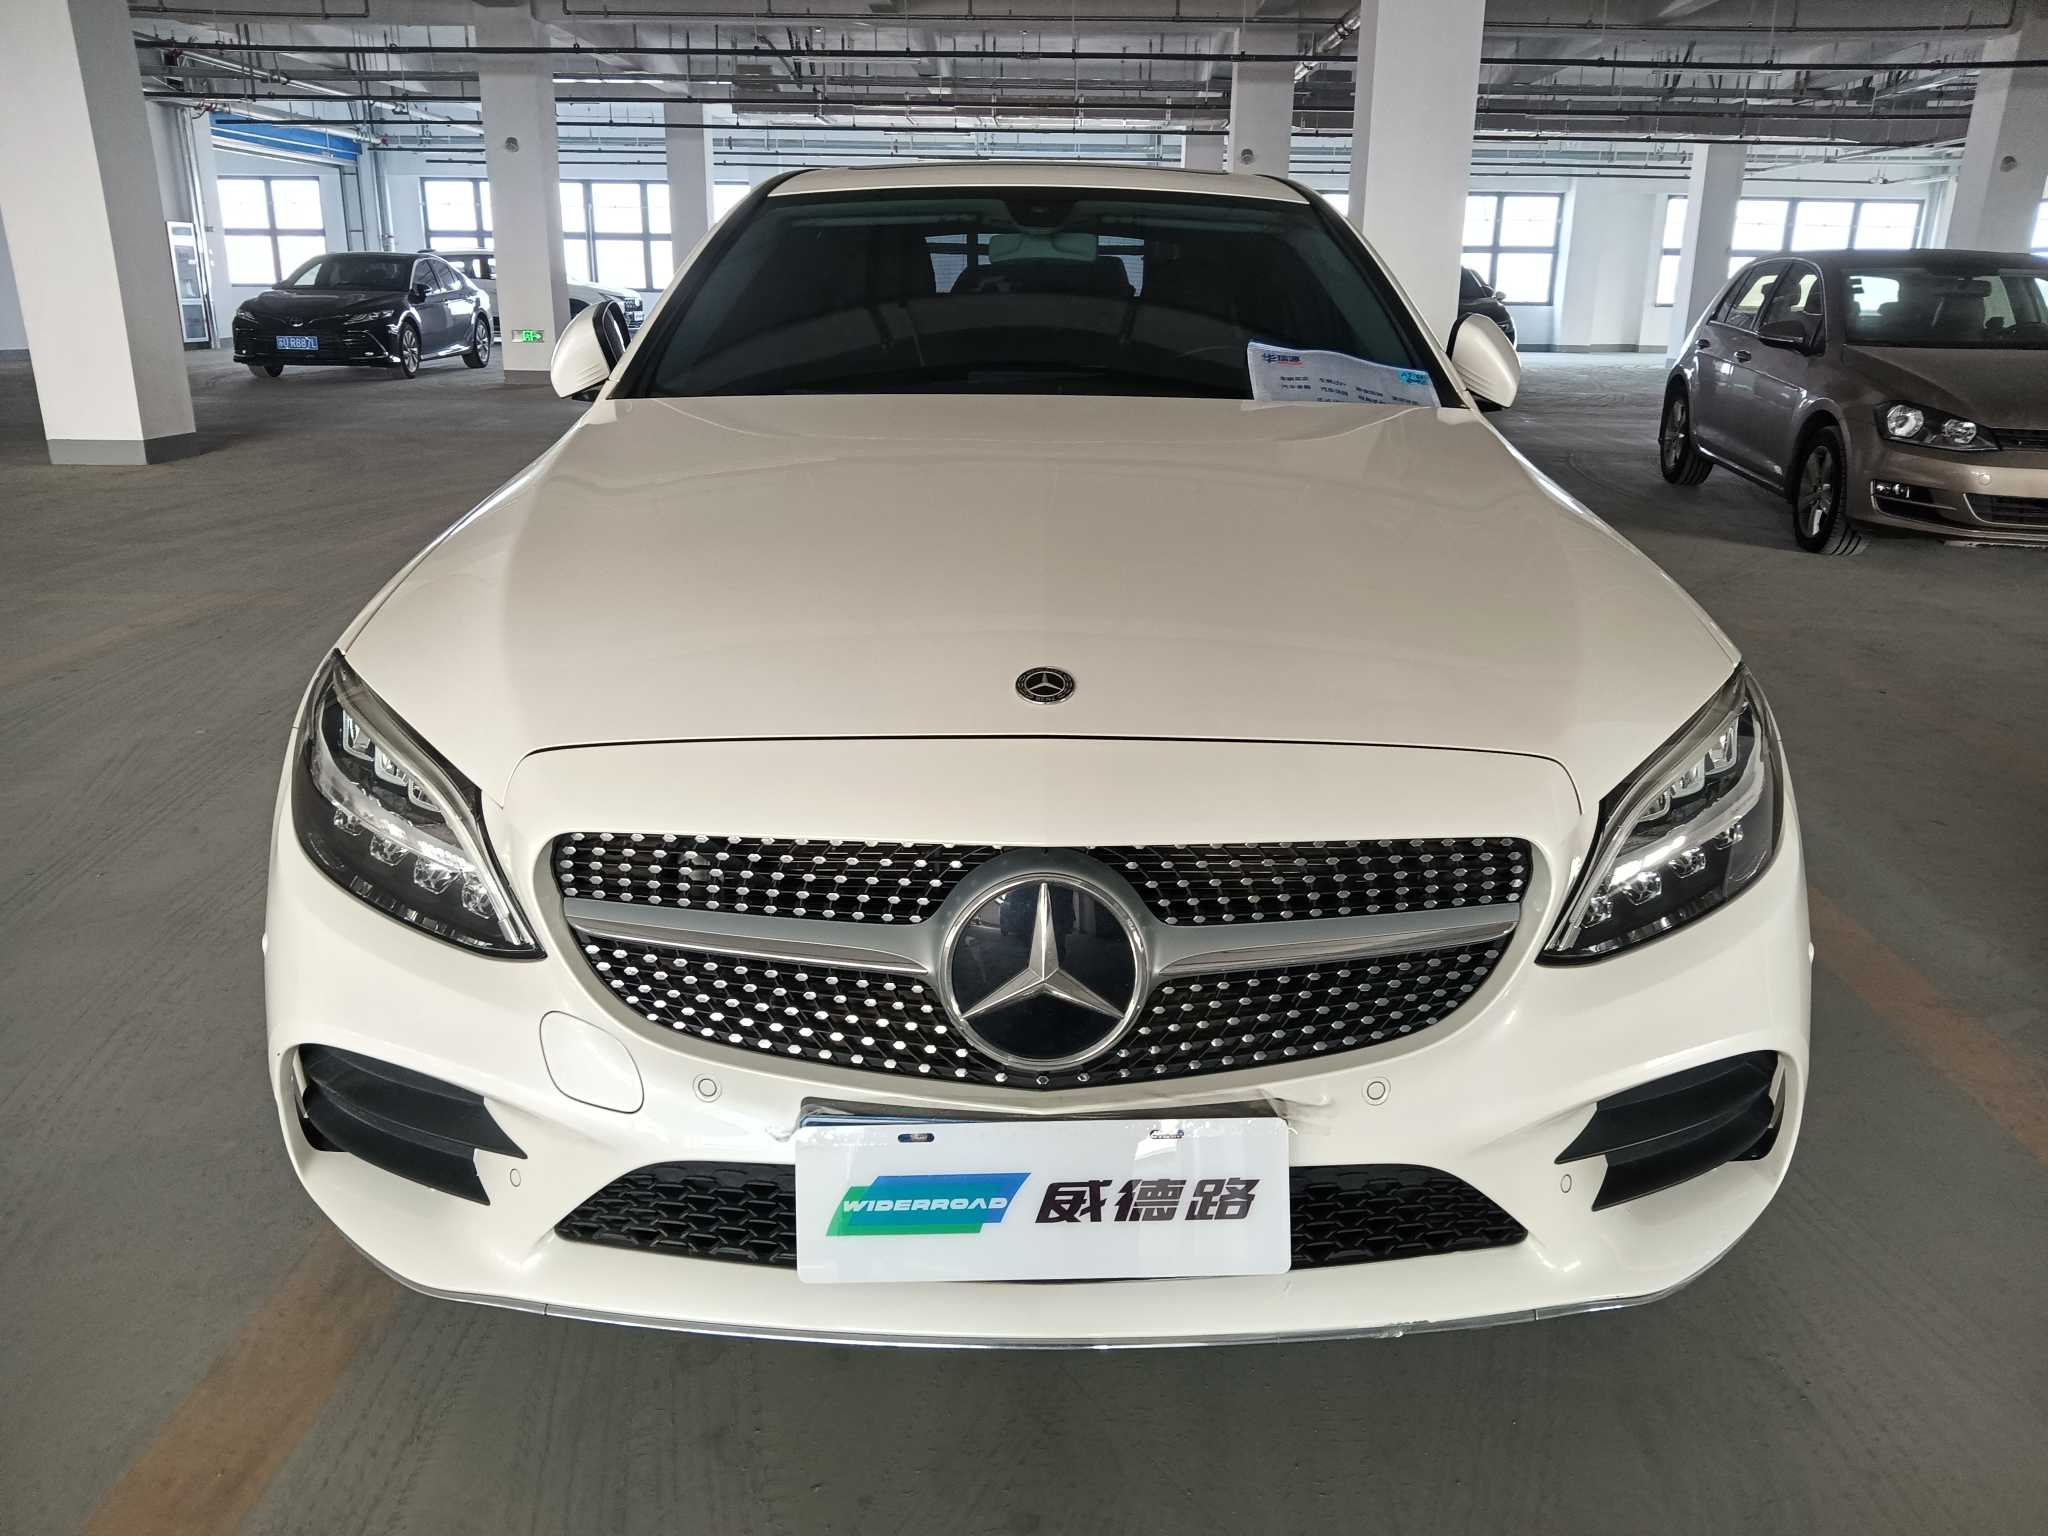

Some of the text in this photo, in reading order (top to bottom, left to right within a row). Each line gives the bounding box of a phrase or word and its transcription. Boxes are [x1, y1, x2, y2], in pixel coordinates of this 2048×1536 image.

[842, 1197, 1008, 1213] WIDERROAD
[1035, 1178, 1260, 1223] 威德路
